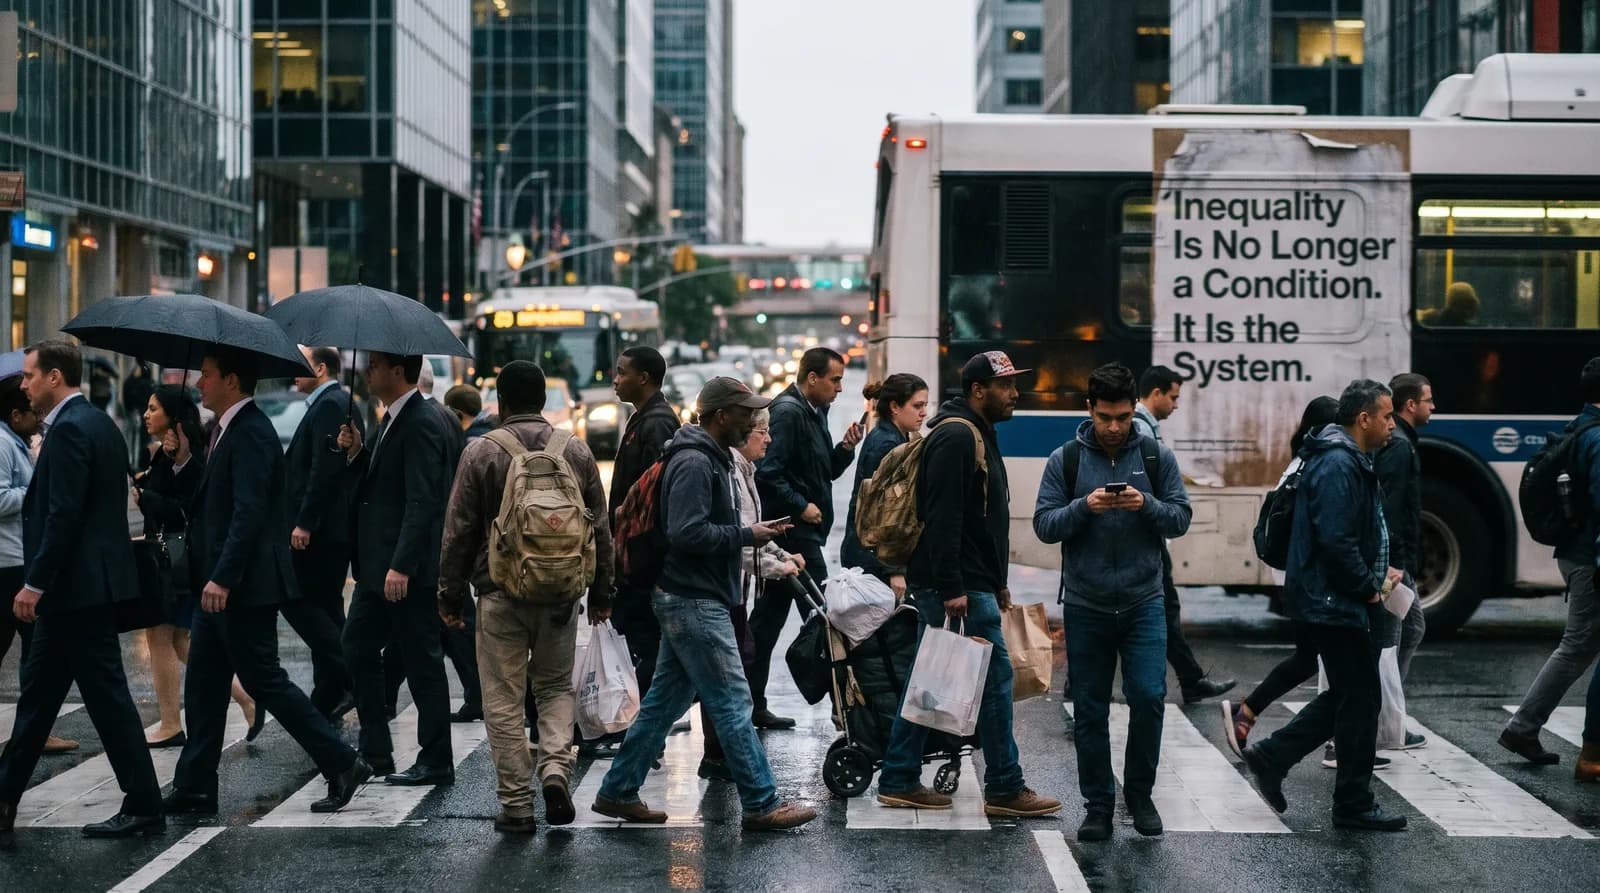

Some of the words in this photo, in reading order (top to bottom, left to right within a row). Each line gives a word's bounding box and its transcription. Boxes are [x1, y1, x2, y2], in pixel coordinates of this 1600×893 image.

[1174, 230, 1203, 260] Is
[1213, 230, 1261, 260] No
[1271, 230, 1396, 267] Longer
[1173, 275, 1193, 299] a
[1203, 268, 1382, 299] Condition.
[1174, 313, 1196, 344] It
[1206, 313, 1234, 344] Is
[1243, 313, 1300, 344] the
[1173, 352, 1312, 389] System.
